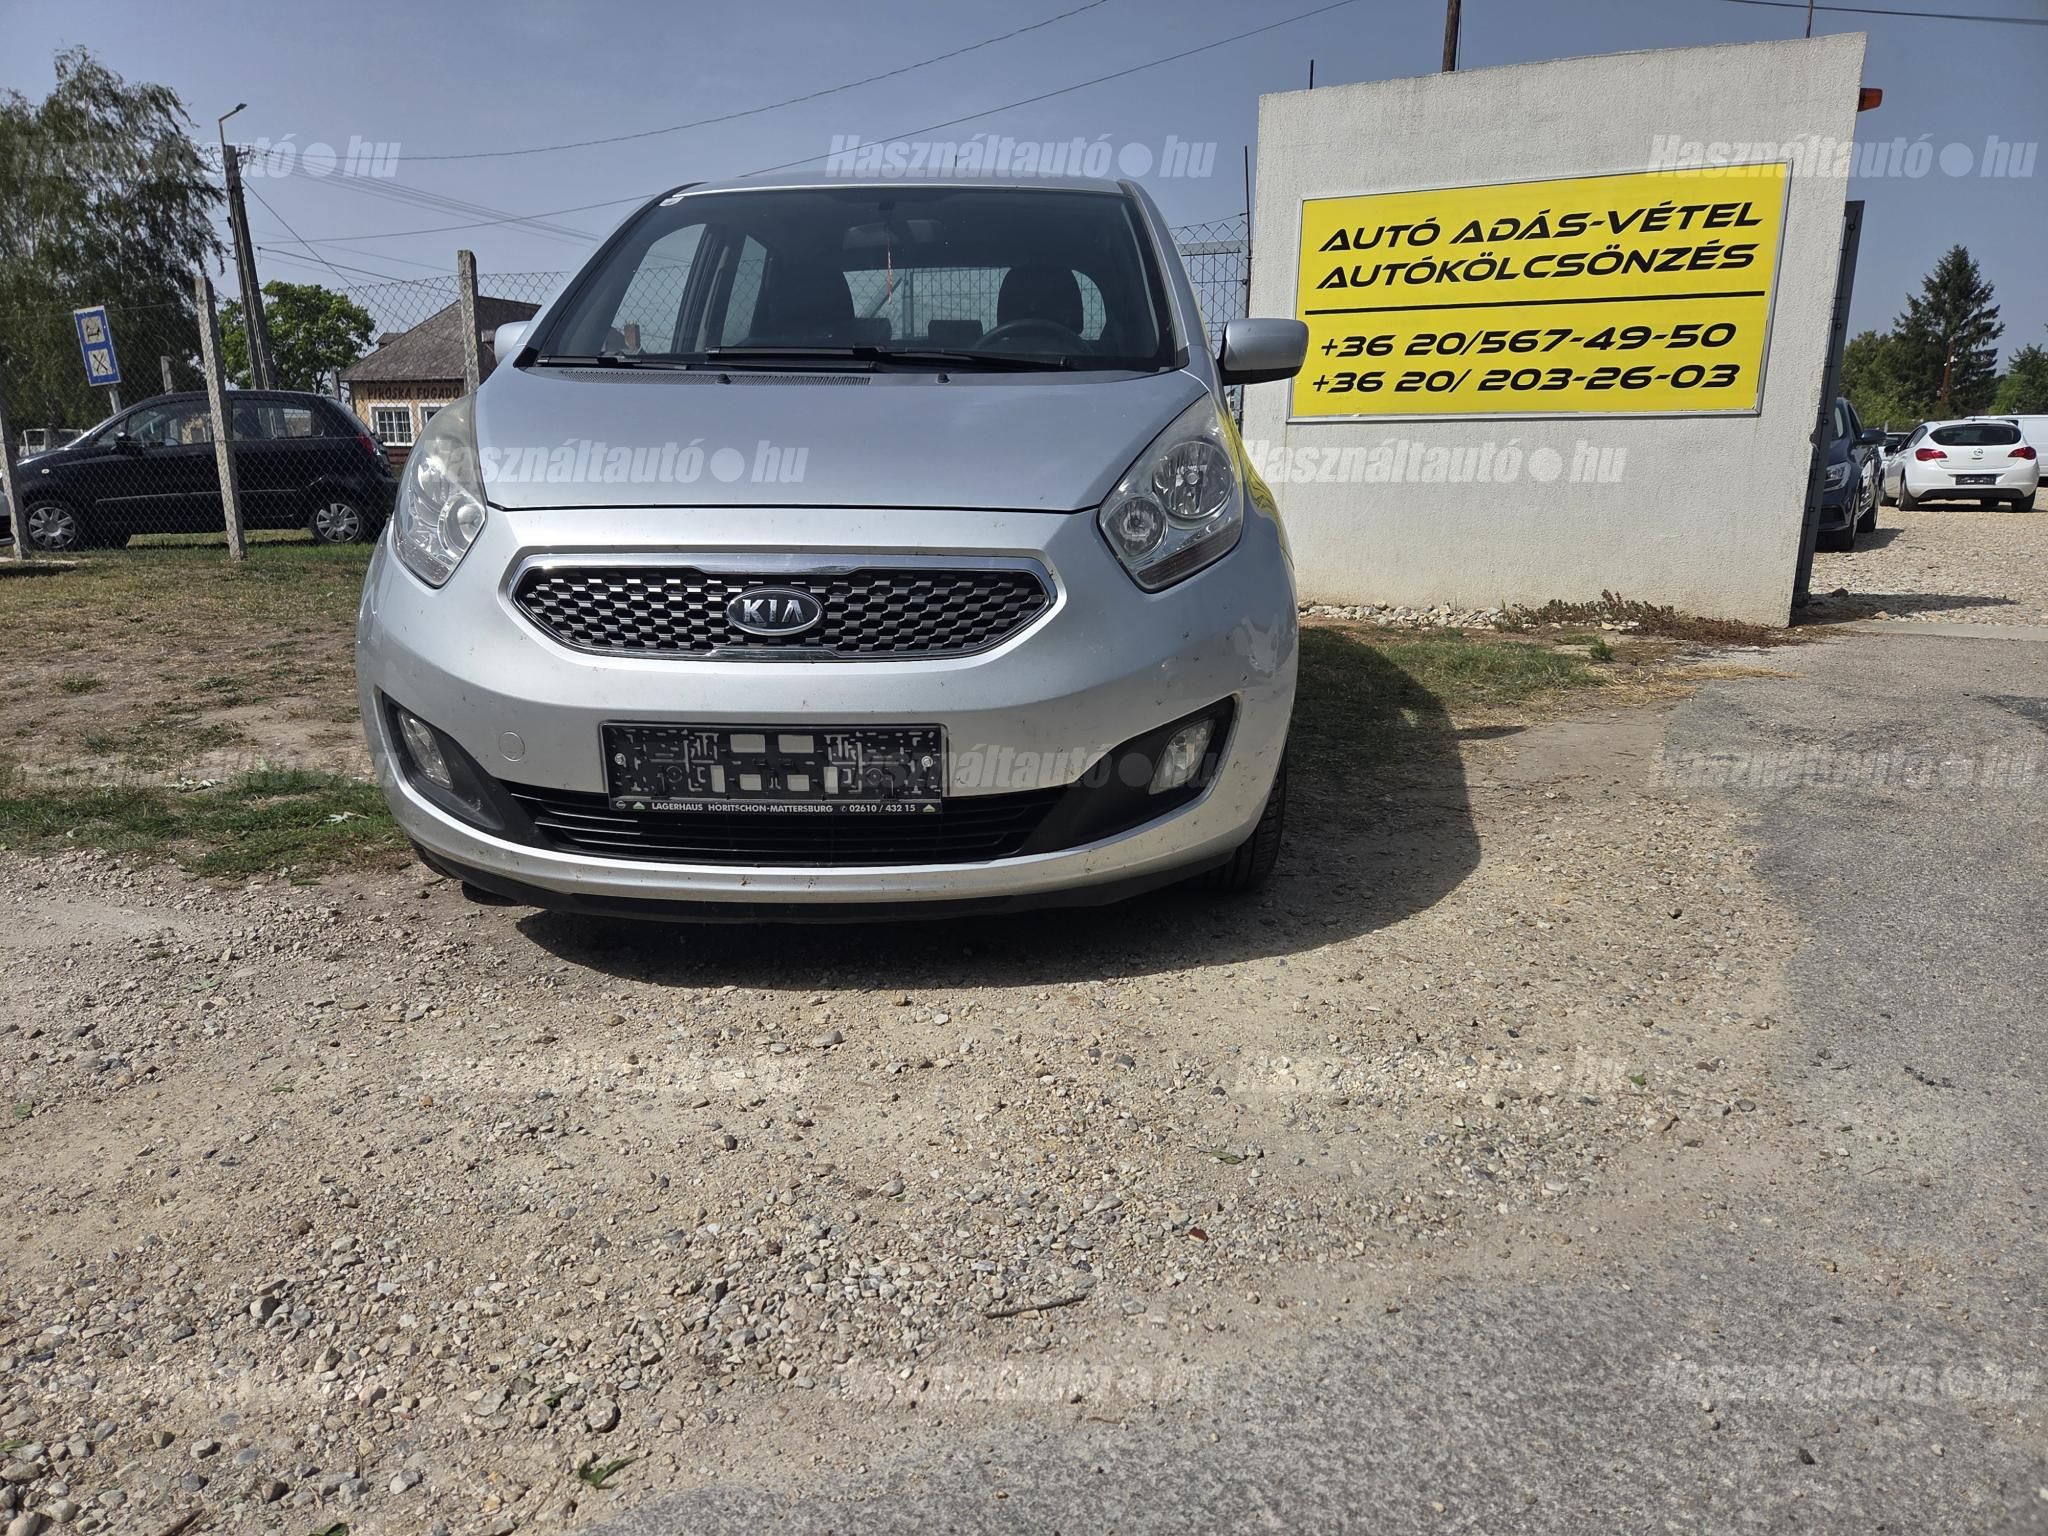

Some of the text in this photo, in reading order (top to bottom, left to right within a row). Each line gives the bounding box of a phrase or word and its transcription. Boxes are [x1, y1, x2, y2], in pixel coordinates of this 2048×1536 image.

[1318, 200, 1763, 252] AUTÓ ADÁS-VÉTEL
[1316, 239, 1760, 289] AUTÓKÖLCSÖNZÉS
[1321, 323, 1737, 357] +36 20/567-49-50
[1312, 364, 1740, 393] +36 20/ 203-26-03
[742, 599, 805, 623] KIA
[651, 802, 703, 811] LAGERHAUS
[849, 804, 877, 812] 02610
[885, 804, 902, 812] 432
[904, 804, 916, 812] 15
